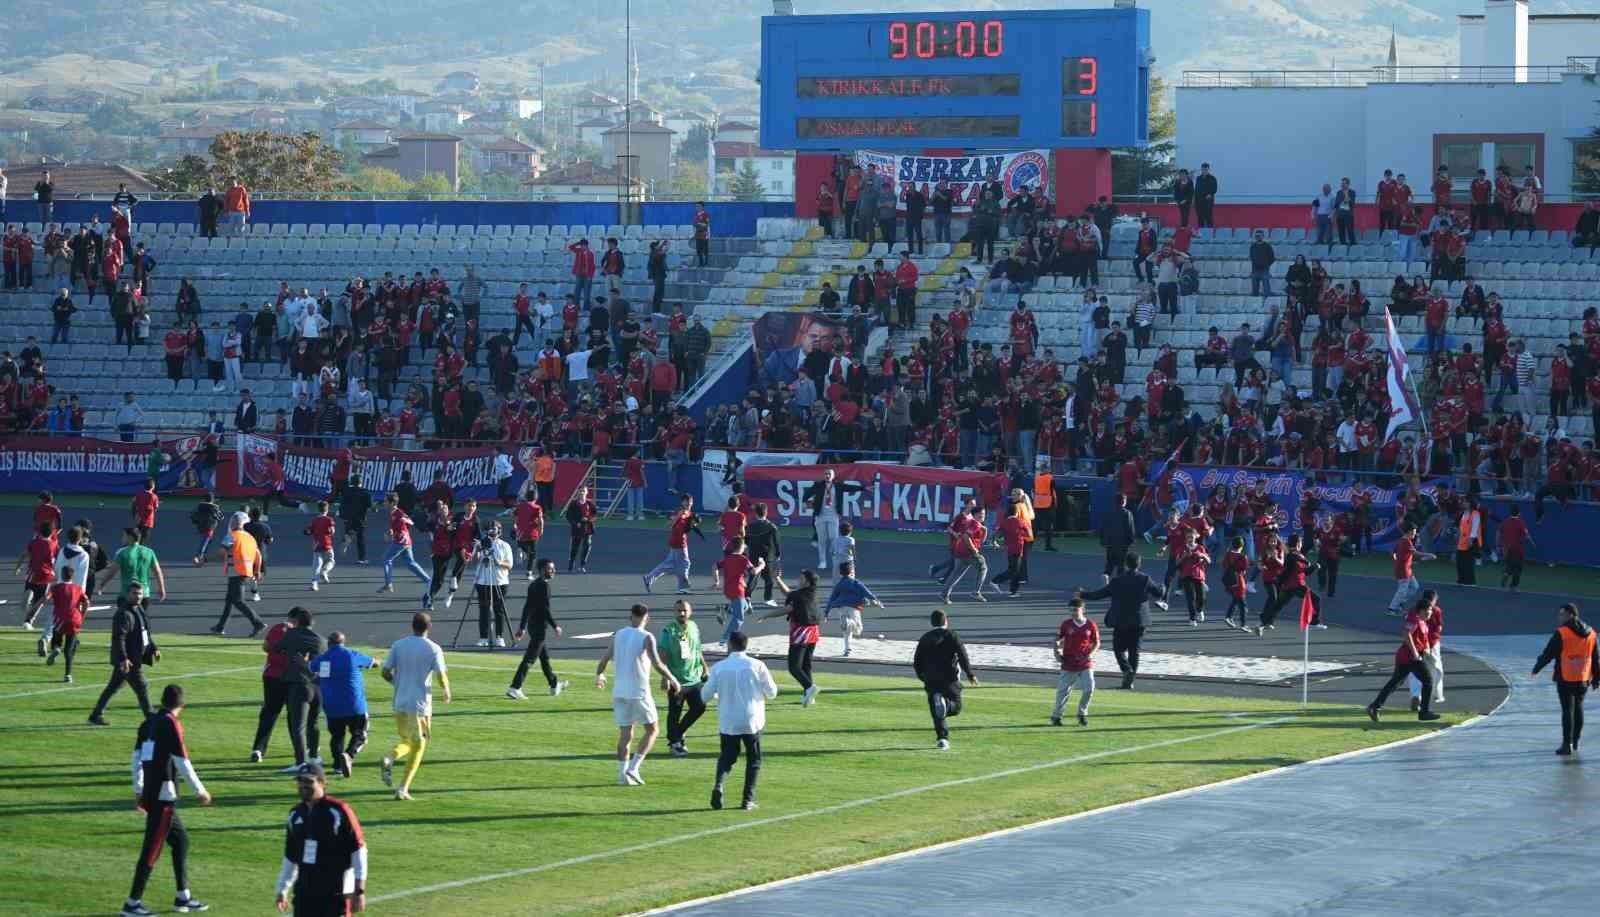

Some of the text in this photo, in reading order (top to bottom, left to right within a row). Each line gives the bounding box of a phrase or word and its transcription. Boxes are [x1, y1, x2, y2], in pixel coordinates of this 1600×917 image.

[889, 21, 1004, 58] 90:00
[1079, 57, 1098, 96] 3
[1089, 102, 1097, 136] 1
[900, 155, 1005, 182] SERKAN
[776, 472, 882, 526] ŞER-İ
